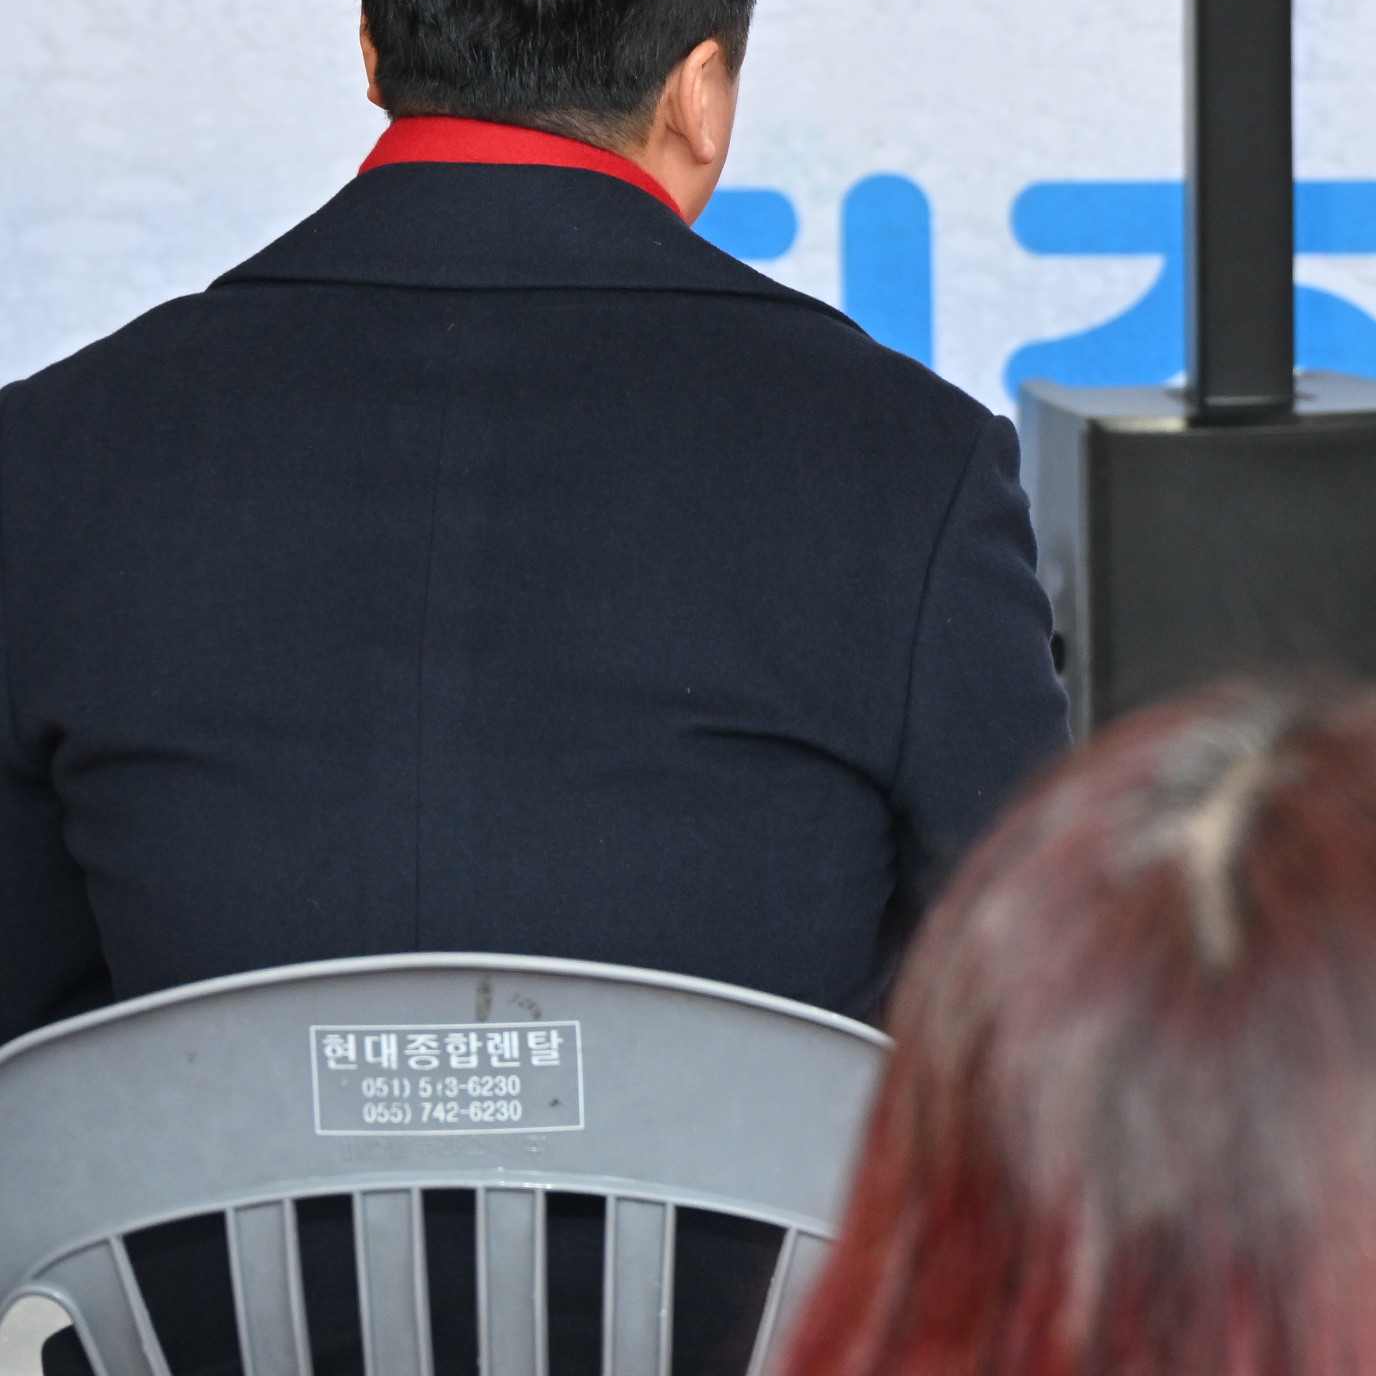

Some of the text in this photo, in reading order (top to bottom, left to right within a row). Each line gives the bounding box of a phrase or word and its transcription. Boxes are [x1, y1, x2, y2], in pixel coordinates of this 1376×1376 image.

[322, 1030, 564, 1070] 현대종합렌탈
[361, 1077, 411, 1099] 051)
[362, 1099, 523, 1124] 055) 742-6230
